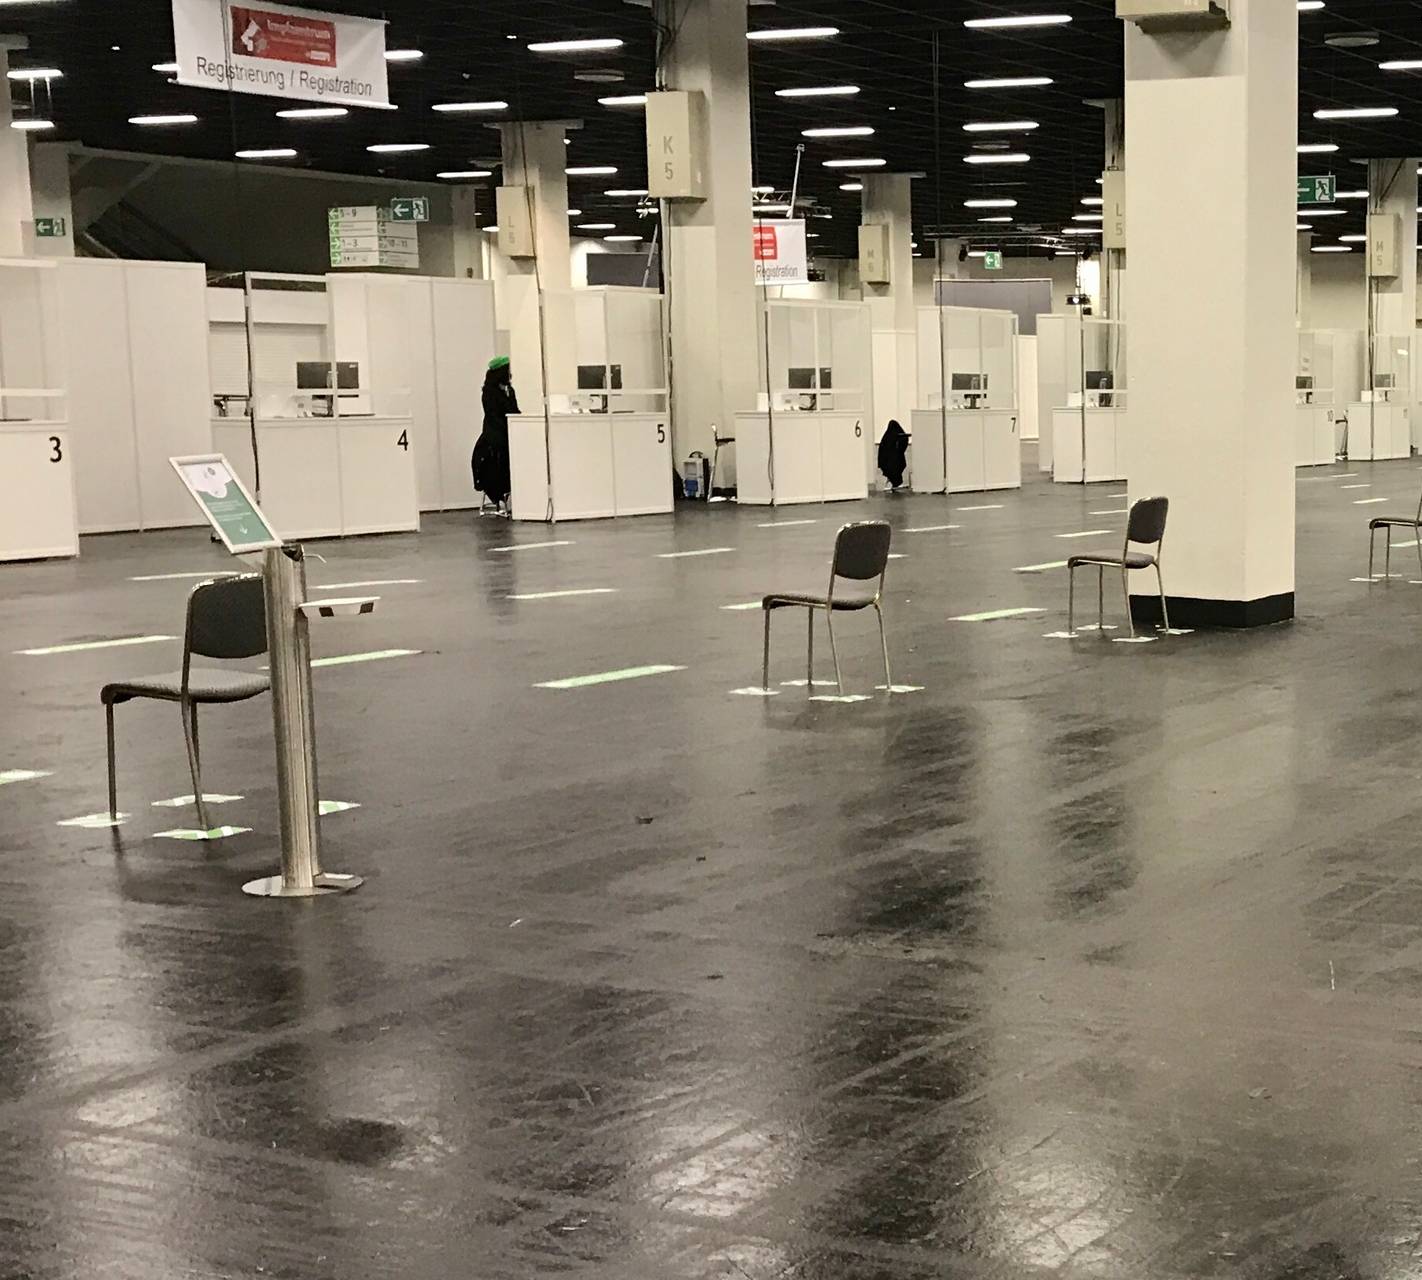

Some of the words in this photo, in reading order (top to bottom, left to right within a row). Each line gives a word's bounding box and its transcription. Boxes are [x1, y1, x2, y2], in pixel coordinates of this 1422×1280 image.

[196, 56, 285, 90] Registrierung
[300, 70, 372, 96] Registration
[663, 136, 674, 154] K
[664, 162, 674, 180] 5
[1116, 203, 1122, 217] L
[1115, 222, 1123, 236] 5
[755, 264, 799, 280] Registration
[657, 423, 665, 444] 5
[855, 420, 862, 438] 6
[1010, 417, 1017, 433] 7
[397, 429, 409, 451] 4
[49, 436, 62, 463] 3
